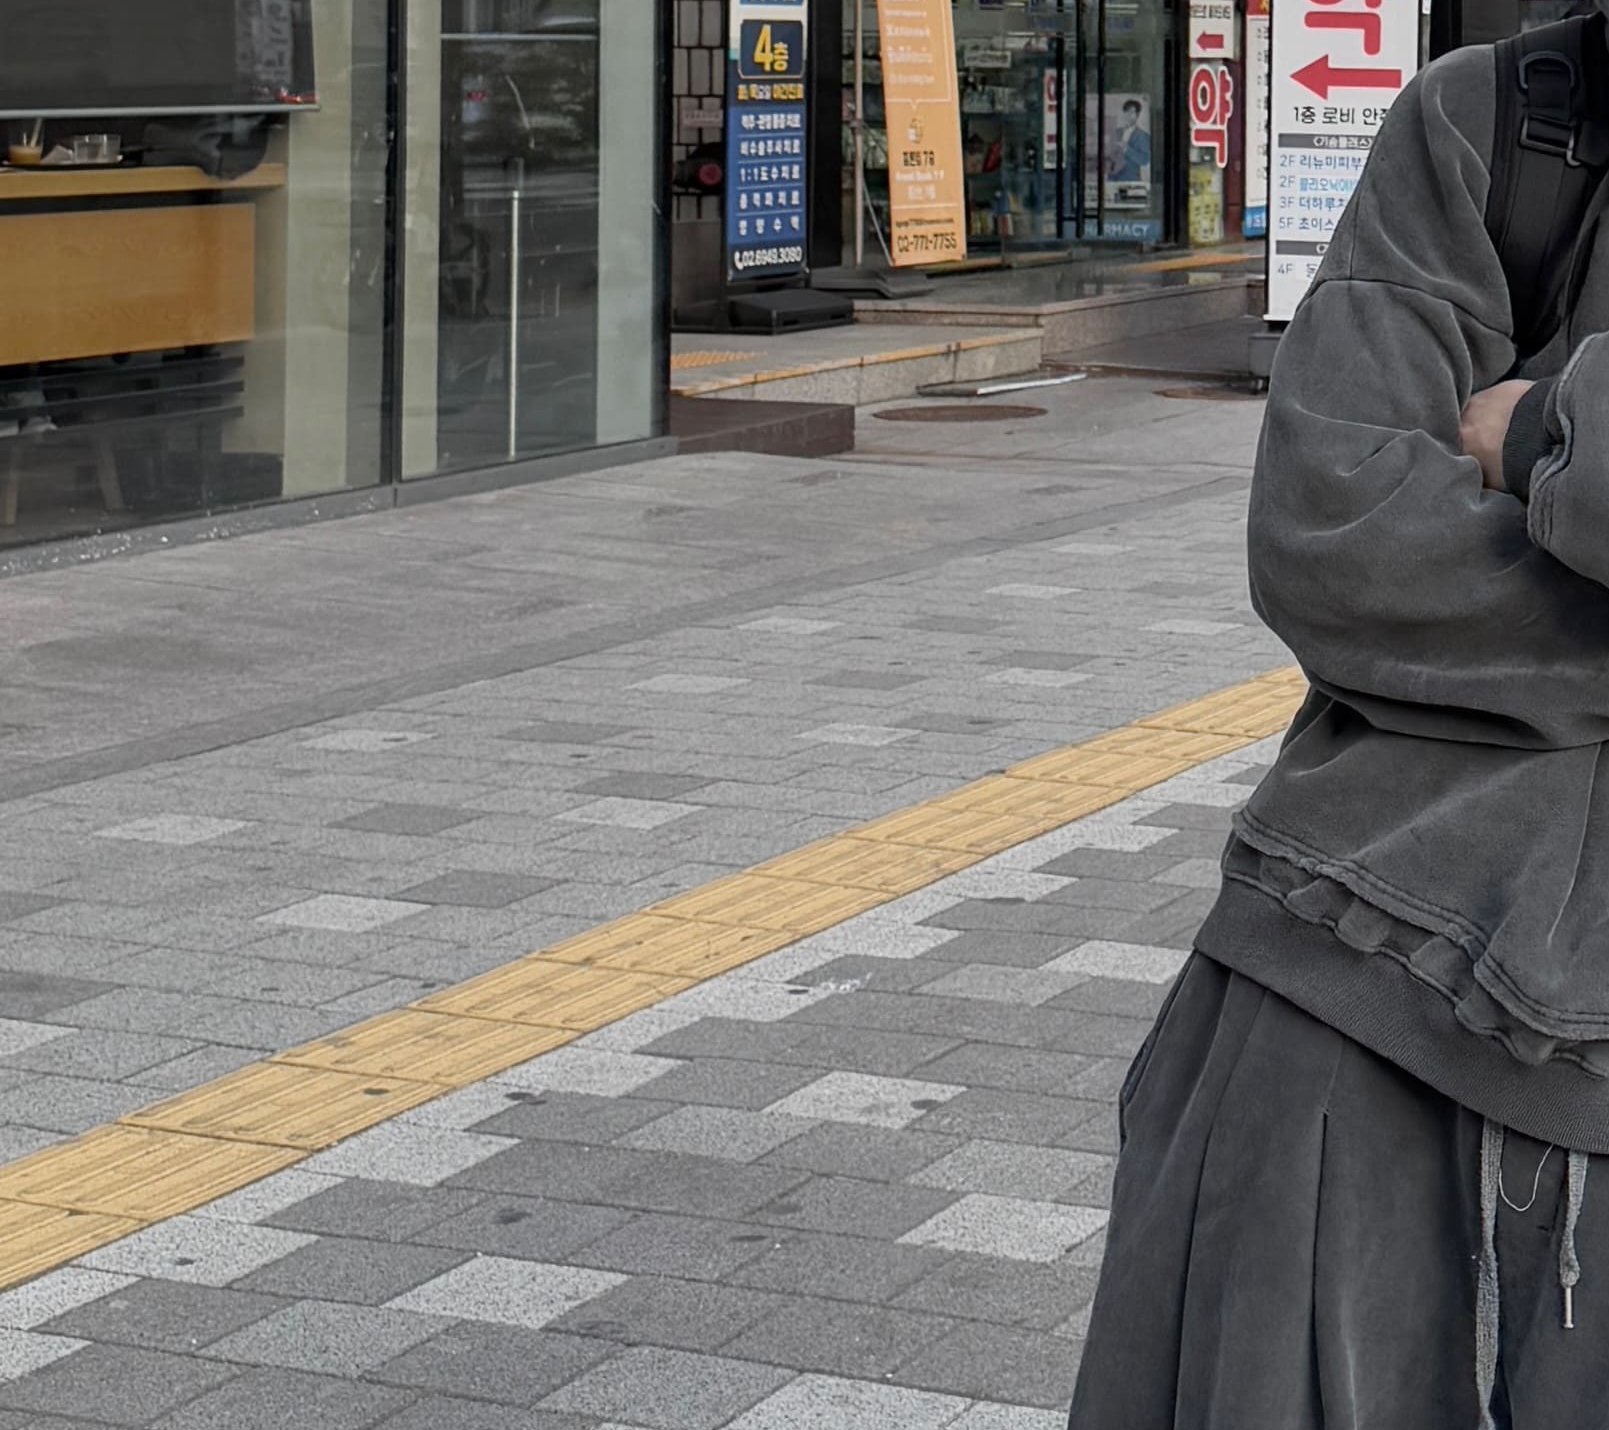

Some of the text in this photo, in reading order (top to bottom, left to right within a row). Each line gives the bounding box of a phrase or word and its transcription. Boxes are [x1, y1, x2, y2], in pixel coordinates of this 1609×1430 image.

[752, 23, 790, 73] 4층
[1190, 66, 1232, 168] 약
[1293, 105, 1317, 125] 1층
[1322, 106, 1355, 125] 로비
[1279, 154, 1296, 169] 2F
[1279, 174, 1296, 189] 2F
[1279, 196, 1296, 210] 3F
[1279, 216, 1335, 232] 5F 초이스
[1277, 263, 1294, 275] 4F
